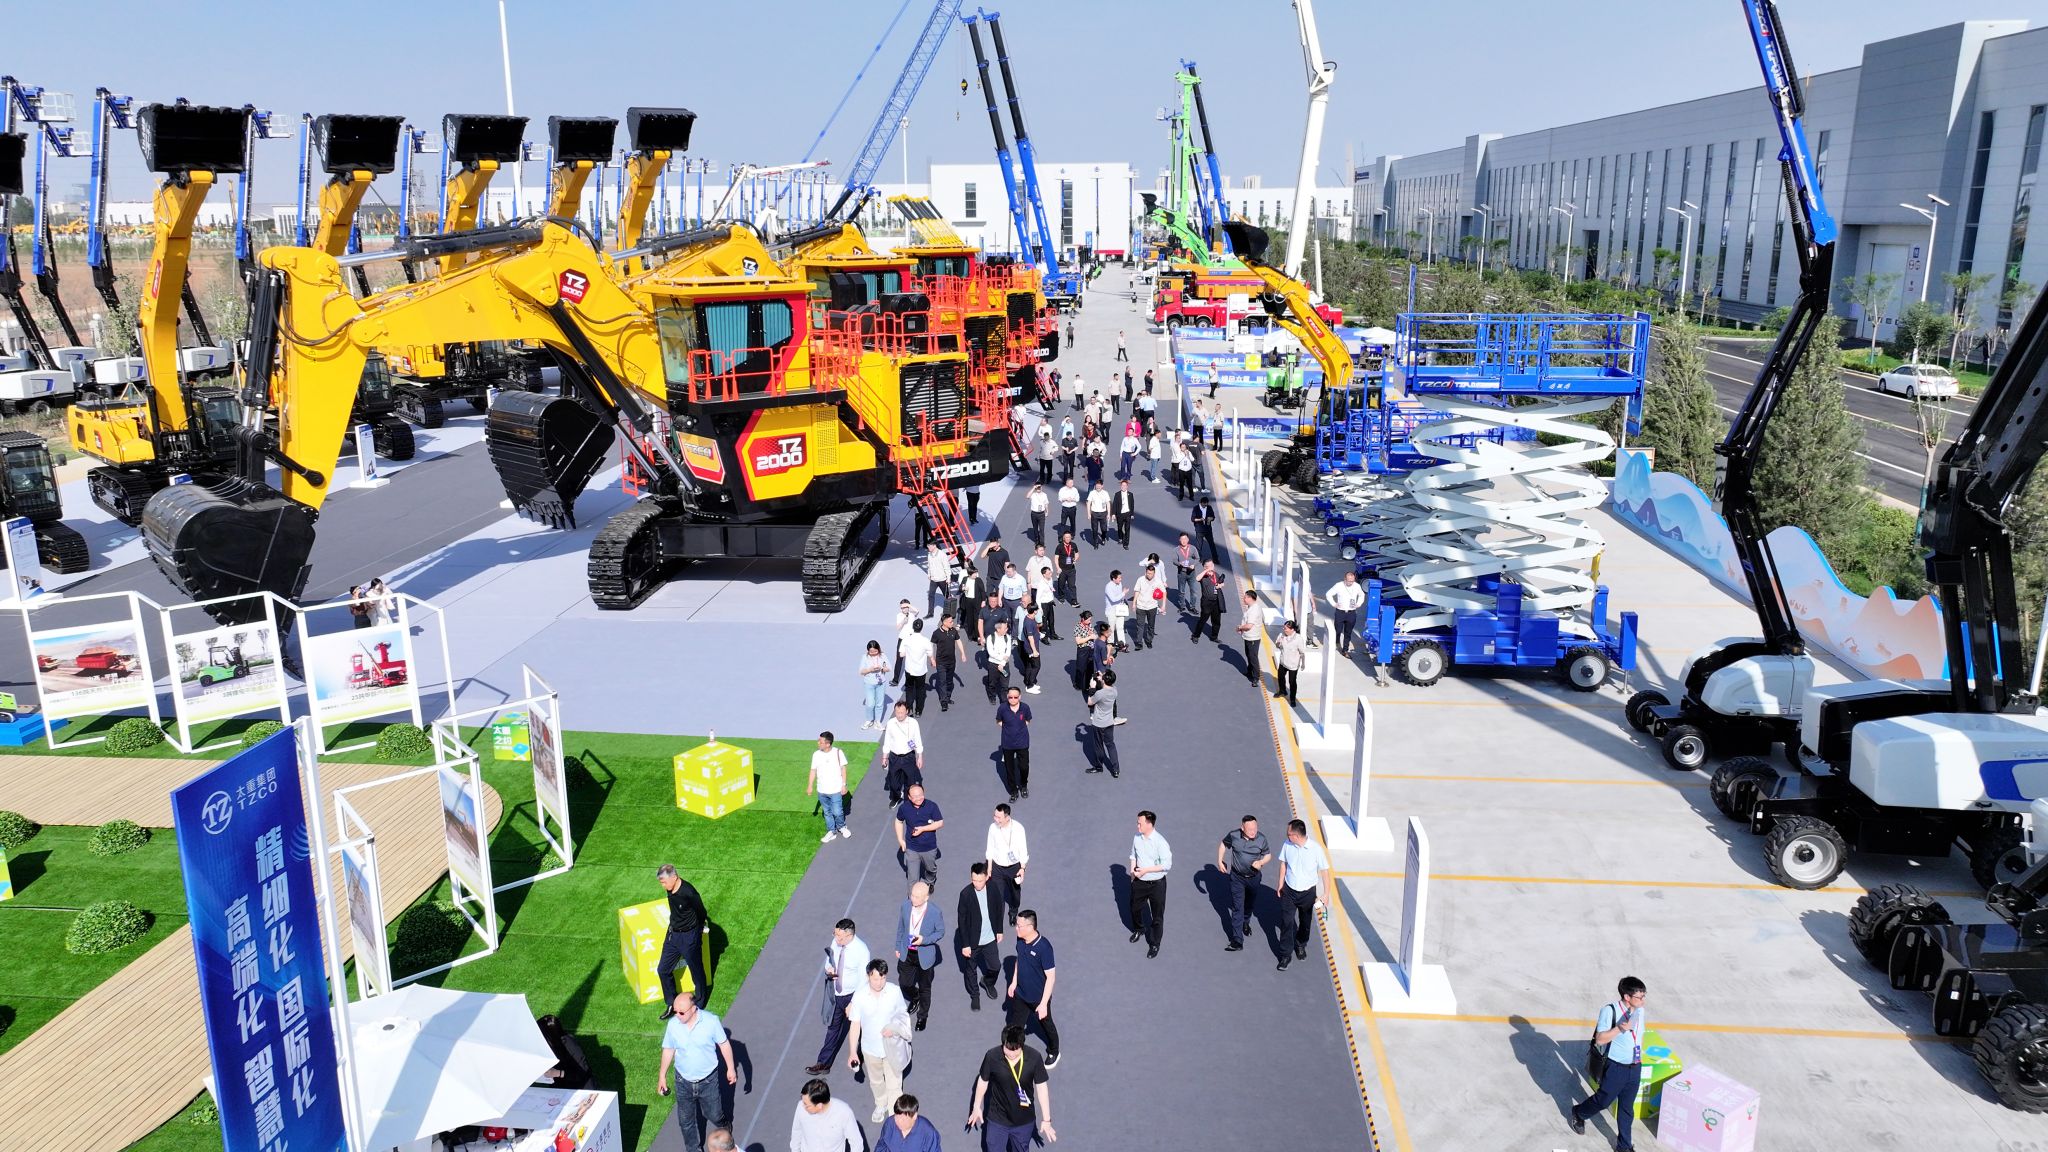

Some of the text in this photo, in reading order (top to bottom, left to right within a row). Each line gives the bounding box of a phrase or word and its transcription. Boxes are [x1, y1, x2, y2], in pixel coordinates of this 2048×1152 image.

[565, 272, 587, 290] TZ
[778, 437, 802, 454] TZ
[756, 451, 803, 471] 2000
[930, 459, 990, 481] TZ2000
[235, 766, 277, 800] 太重集团
[236, 780, 279, 811] TZCO
[223, 893, 267, 1045] 高端化
[254, 824, 318, 1119] 精细化 国际化
